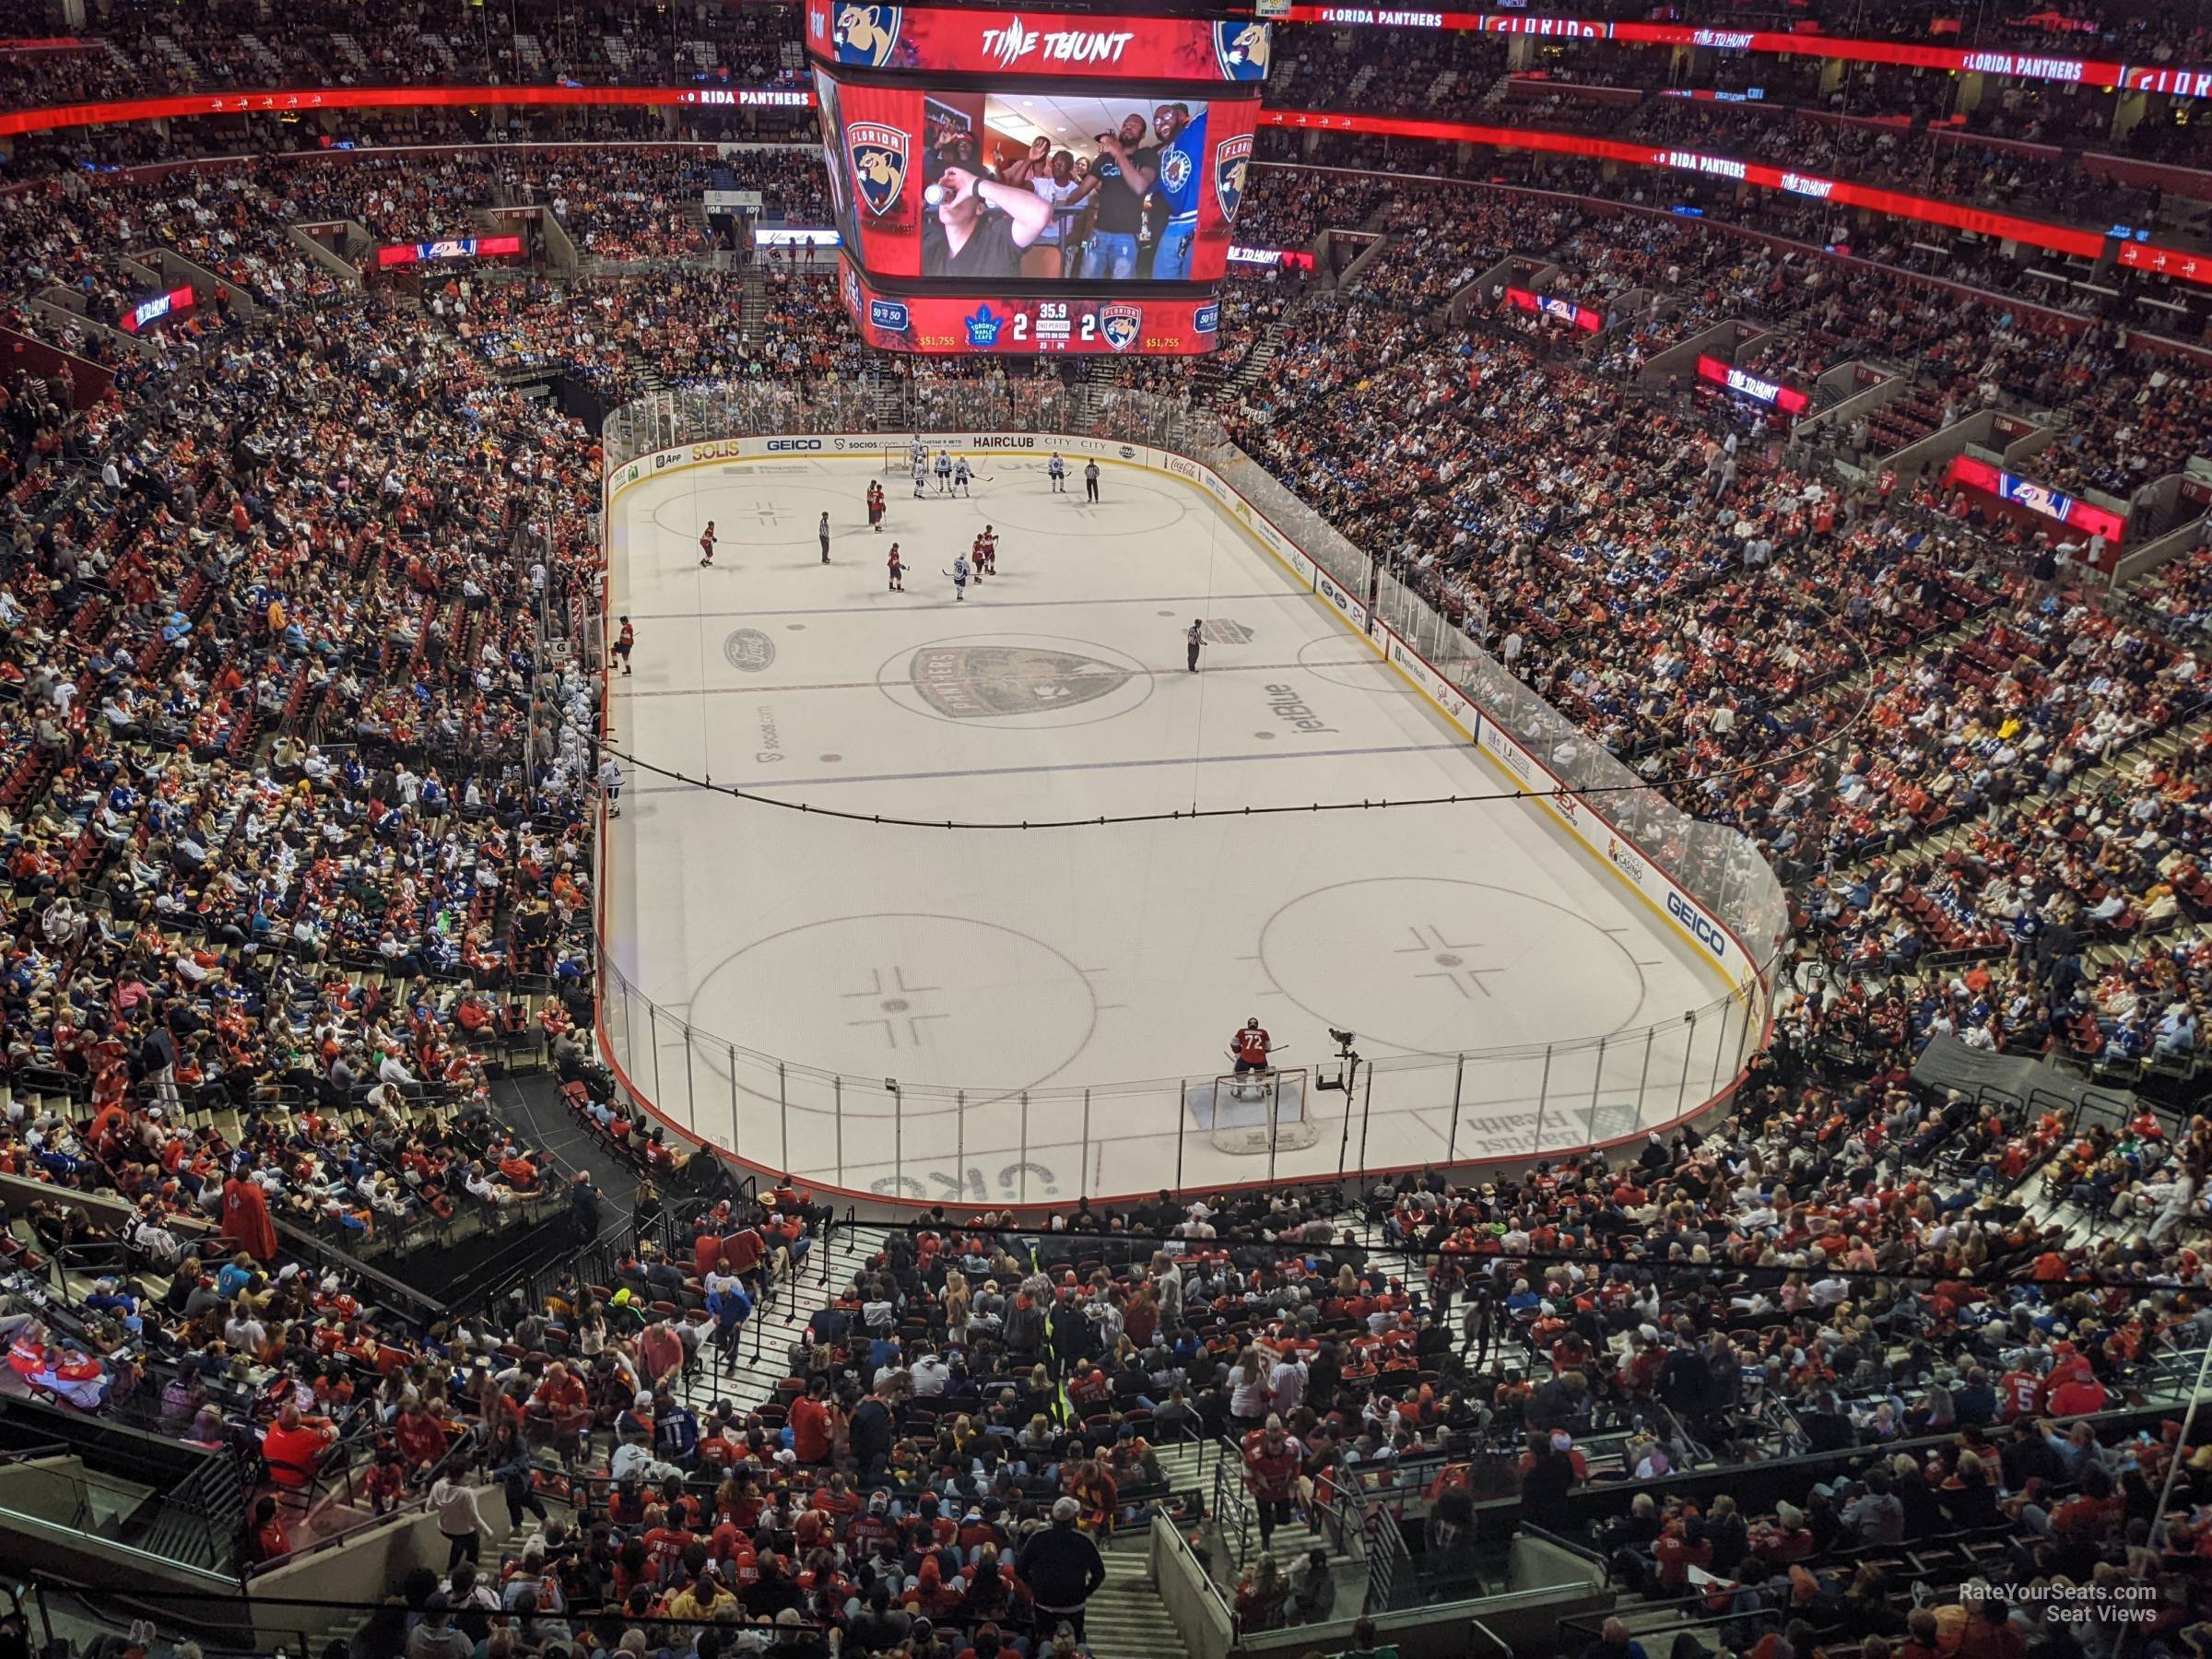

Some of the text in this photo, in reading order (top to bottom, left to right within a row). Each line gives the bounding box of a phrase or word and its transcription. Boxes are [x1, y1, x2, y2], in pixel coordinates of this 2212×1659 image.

[1379, 11, 1442, 27] PANTHERS
[982, 15, 1040, 69] TIME
[1726, 34, 1754, 47] HUNT
[2016, 58, 2083, 80] PANTHERS
[740, 92, 808, 105] PANTHERS
[852, 130, 899, 147] FLORIDA
[1700, 157, 1746, 179] PANTHERS
[1254, 250, 1282, 264] HUNT
[873, 308, 881, 318] 50
[889, 311, 900, 321] 50
[1040, 303, 1066, 318] 35.9
[1106, 307, 1136, 316] FLORIDA
[971, 323, 997, 332] TORONTO
[1014, 313, 1028, 340] 2
[1081, 314, 1096, 340] 2
[920, 336, 955, 347] $51,755
[1146, 338, 1180, 347] $51,755
[1757, 381, 1779, 400] HUNT
[767, 440, 822, 451] GEICO
[973, 437, 1034, 448] HAIRCLUB
[1045, 438, 1072, 446] CITY
[1081, 441, 1106, 451] CITY
[693, 441, 739, 461] SOLIS
[557, 643, 566, 653] G
[928, 653, 981, 710] PANTHERS
[1265, 684, 1339, 734] jetBlue
[1556, 803, 1578, 827] imaging
[1618, 854, 1642, 879] CASINO
[1667, 890, 1725, 957] GEICO
[1244, 1034, 1263, 1049] 72
[1465, 1110, 1573, 1135] Health
[2017, 1389, 2033, 1412] 5
[665, 1423, 683, 1448] 11
